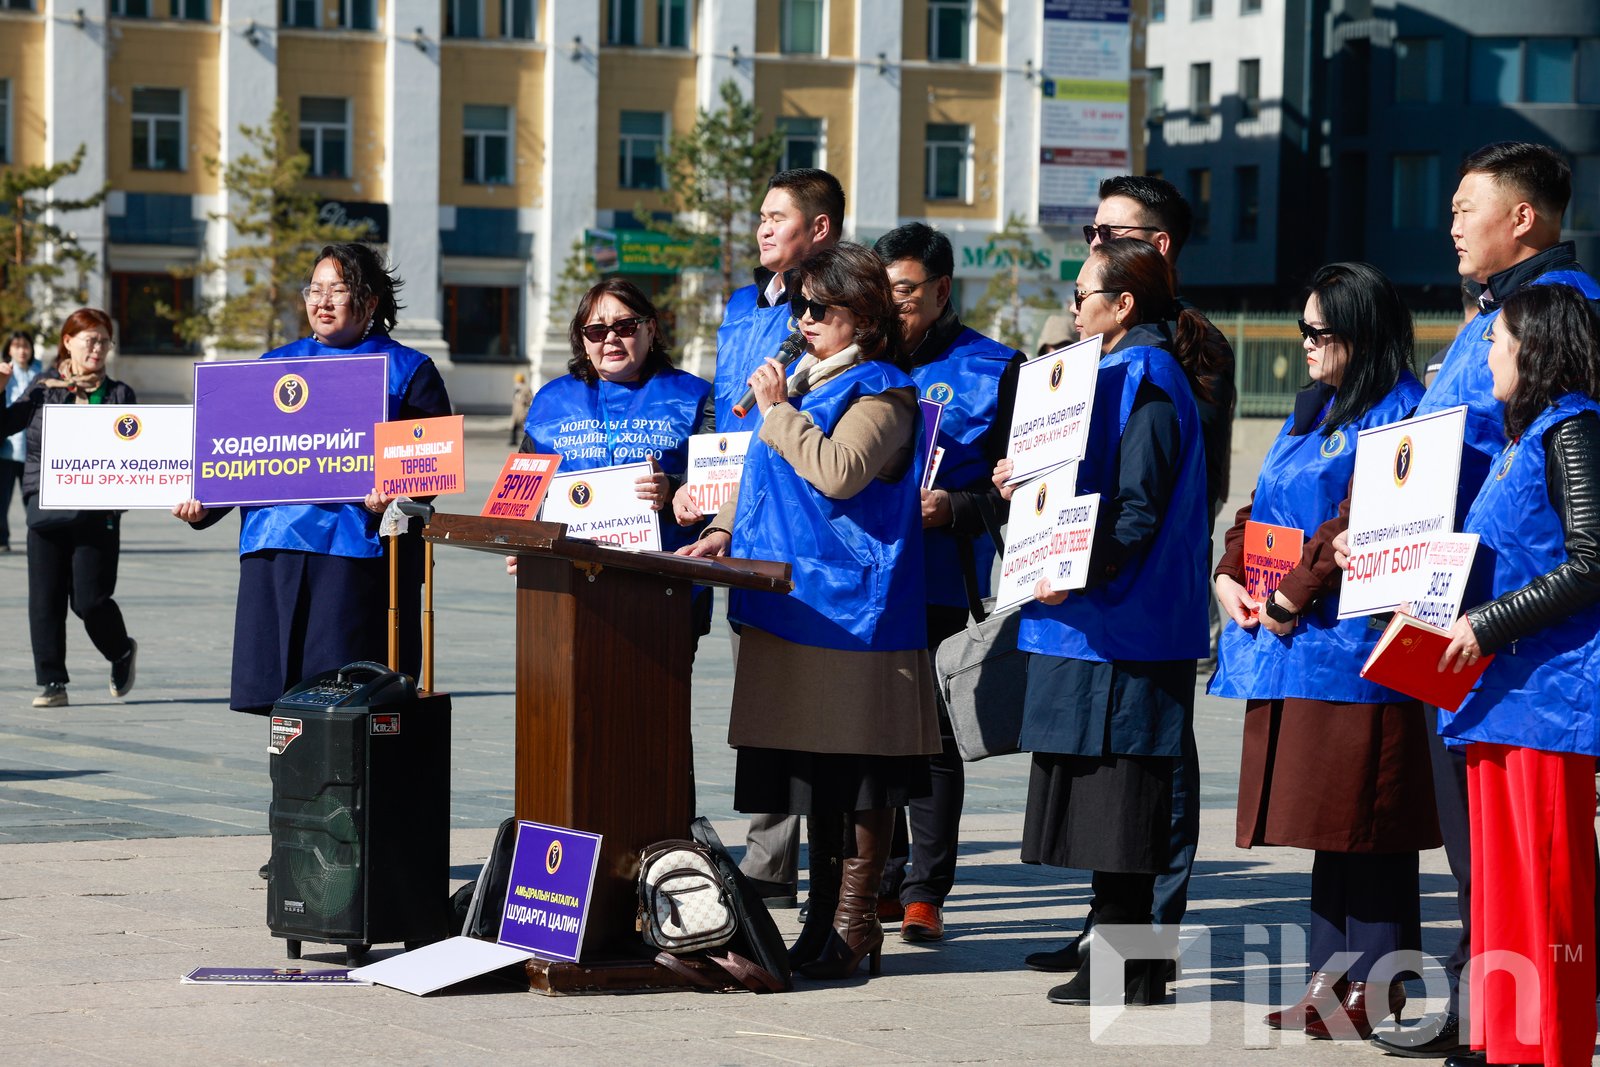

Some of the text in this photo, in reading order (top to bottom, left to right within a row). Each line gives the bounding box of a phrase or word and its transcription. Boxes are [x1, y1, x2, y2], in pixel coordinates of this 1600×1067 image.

[632, 419, 673, 432] ЭРҮҮЛ
[1013, 402, 1086, 438] ШУДАРГА ХӨДӨЛМӨР
[211, 428, 366, 456] ХӨДӨЛМӨРИЙГ
[553, 432, 608, 449] МЭНДИЙН
[1013, 420, 1081, 455] ТЭГШ ЭРХ-ХҮН БҮРТ
[383, 441, 454, 459] АЖЛЫН ХУВЦСЫГ
[564, 447, 606, 461] ҮЭ-ИЙН
[51, 459, 192, 471] ШУДАРГА ХӨДӨЛМӨ
[201, 455, 374, 480] БОДИТООР ҮНЭЛ!
[401, 457, 437, 475] ТӨРӨӨС
[56, 474, 192, 484] ТЭГШ ЭРХ-ХҮН БҮРТ
[383, 474, 457, 495] САНХҮҮЖҮҮЛ!!!
[497, 474, 543, 500] ЭРҮҮЛ
[590, 513, 651, 531] ХАНГАХУЙЦ
[1004, 554, 1029, 577] ЦАЛИН
[1347, 549, 1390, 584] БОДИТ
[1391, 541, 1430, 574] БОЛГ
[514, 885, 579, 908] АМЬДРАЛЫН БАТАЛГАА
[506, 903, 580, 934] ШУДАРГА ЦАЛИН
